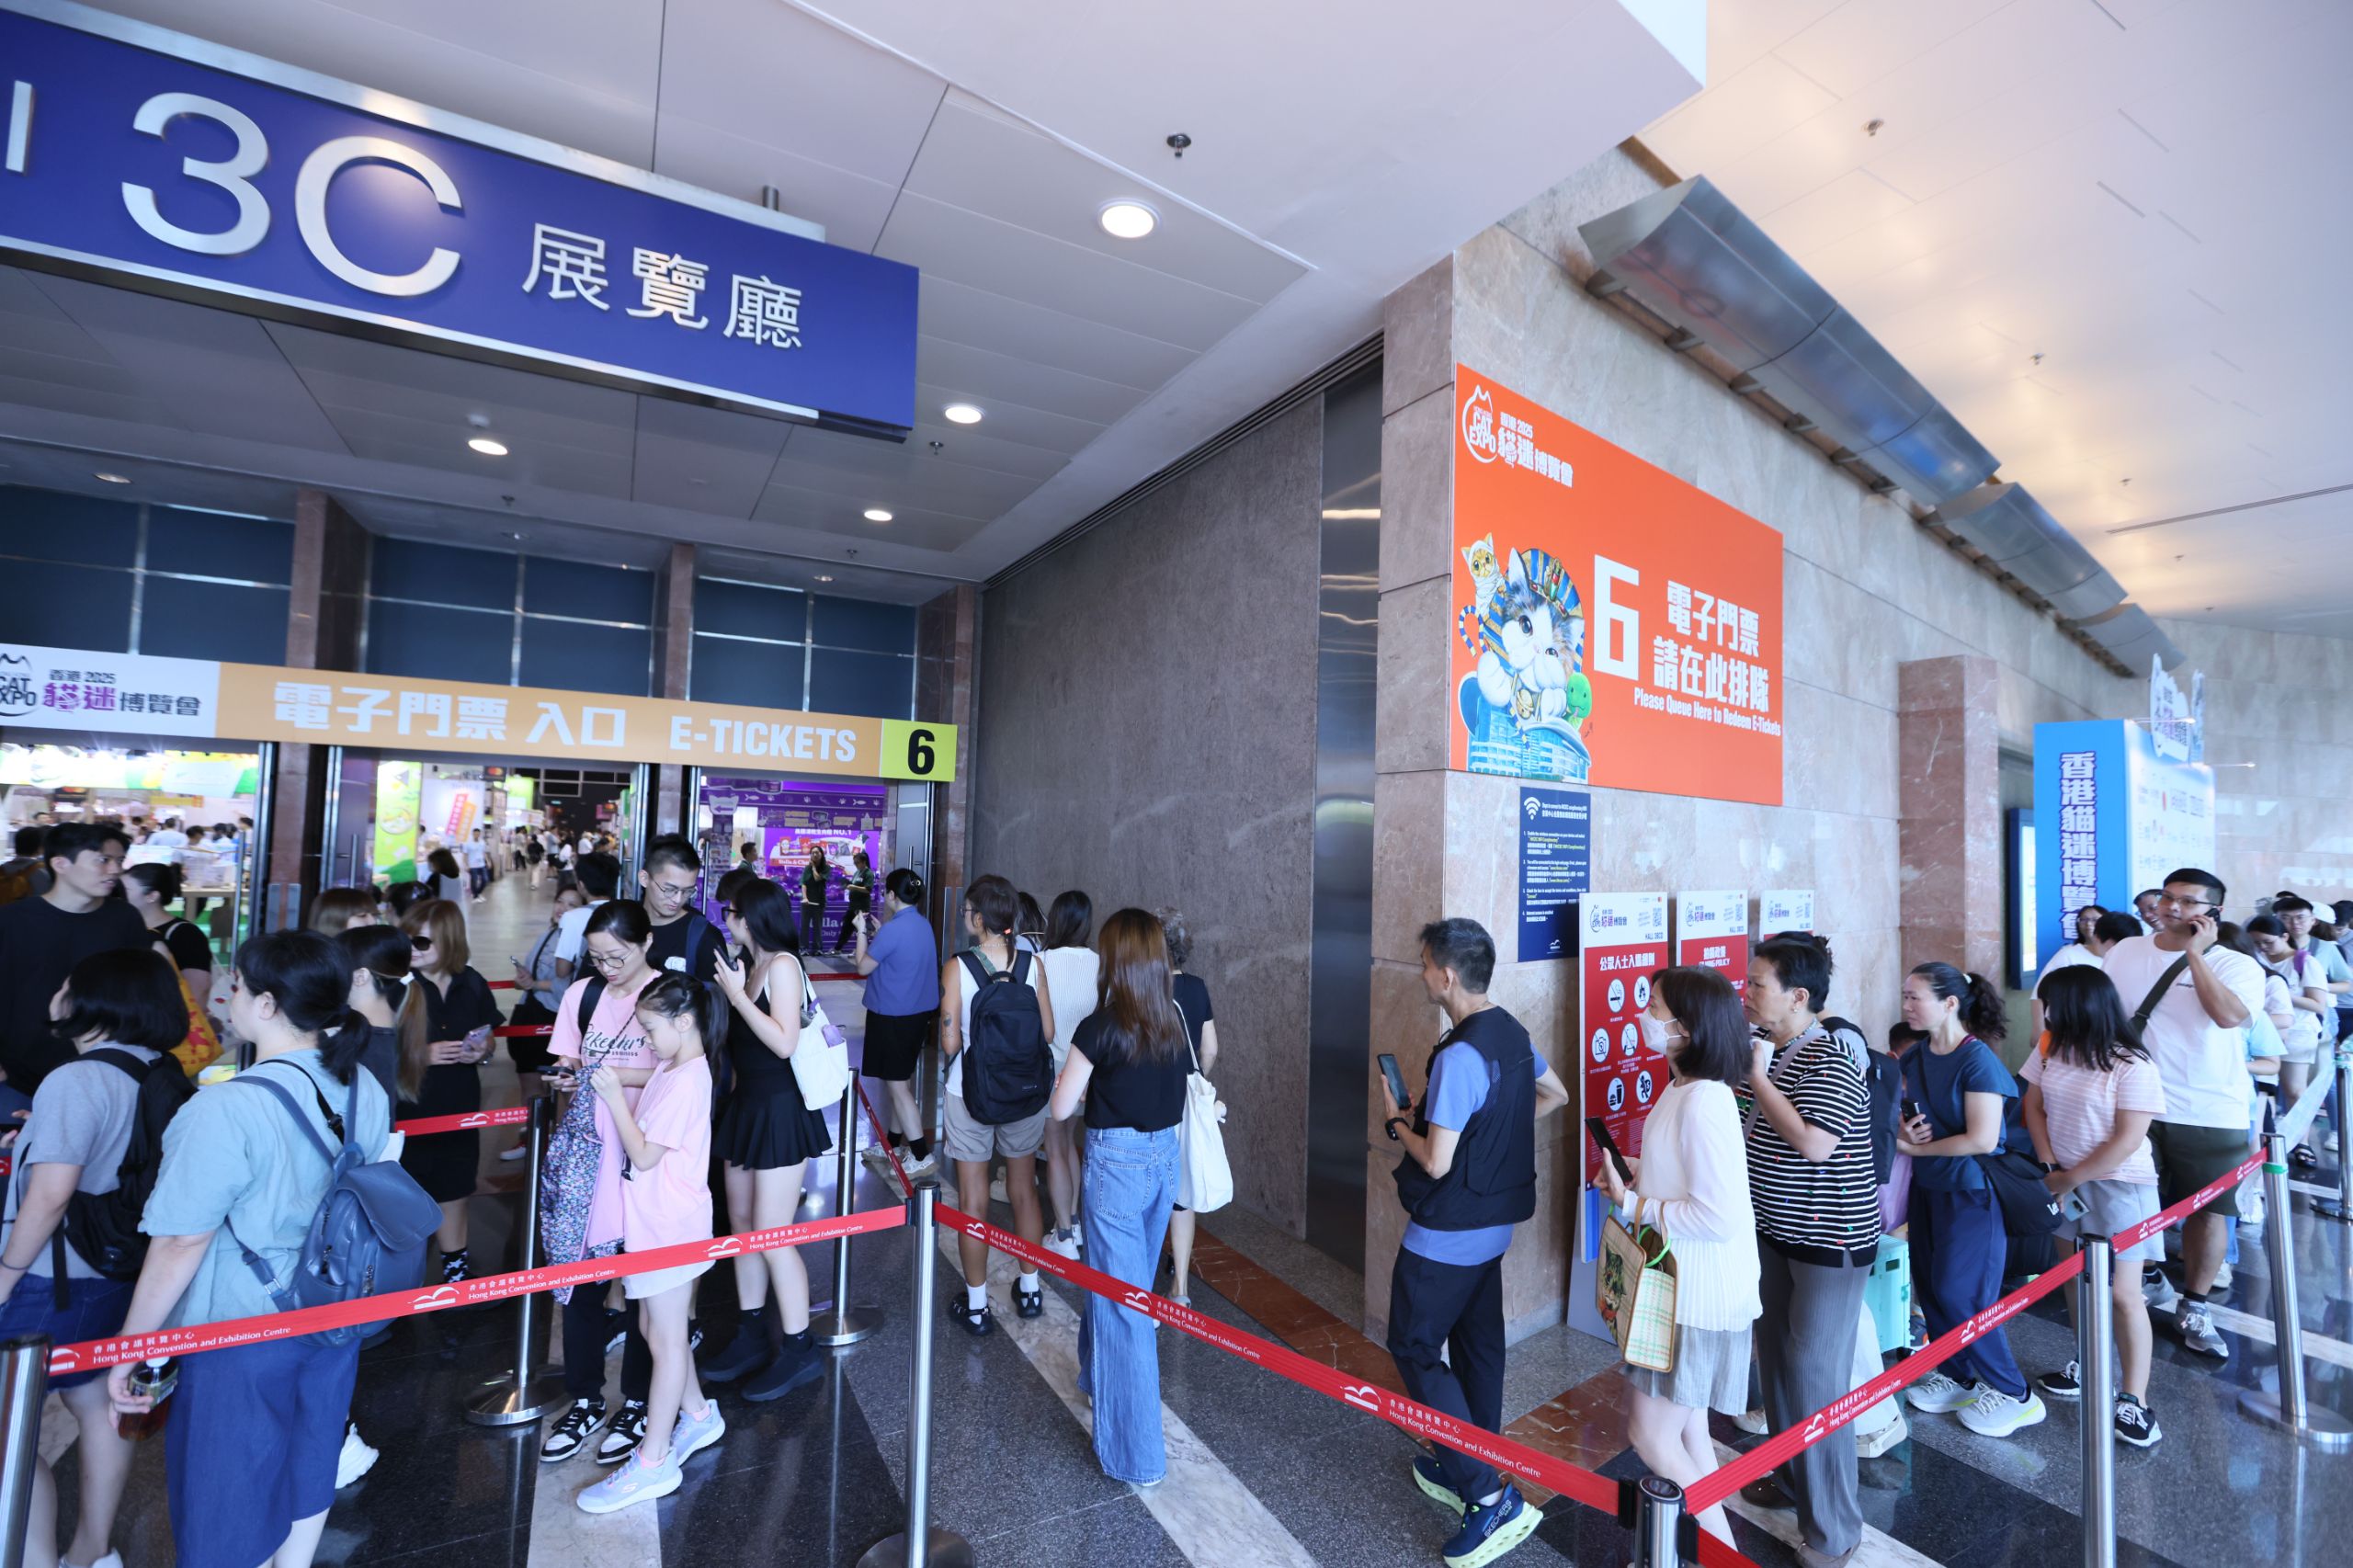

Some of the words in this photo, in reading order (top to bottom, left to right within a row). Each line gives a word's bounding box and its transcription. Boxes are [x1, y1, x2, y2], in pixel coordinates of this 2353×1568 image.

[121, 92, 462, 298] 3C
[522, 222, 802, 350] 展覽廳
[1470, 425, 1496, 453] EXPO
[1473, 411, 1493, 435] CAT
[1594, 554, 1639, 681] 6
[1667, 580, 1759, 657] 電子門票
[50, 669, 81, 682] 香港
[85, 671, 116, 684] 2025
[1654, 635, 1768, 712] 請在此排隊
[0, 688, 37, 706] XPO
[1634, 687, 1665, 710] Please
[1666, 694, 1692, 717] Queue
[1693, 701, 1712, 721] Here
[1713, 706, 1722, 723] to
[1723, 708, 1752, 730] Redeem
[1753, 715, 1781, 736] E-Tickets
[275, 682, 506, 742] 電子門票
[525, 702, 626, 747] 入口
[670, 715, 857, 762] E-TICKETS
[907, 729, 936, 775] 6
[780, 1235, 809, 1244] Convention
[821, 1228, 846, 1237] Exhibition
[847, 1224, 863, 1233] Centre
[469, 1291, 488, 1301] Hong
[490, 1288, 506, 1297] Kong
[509, 1281, 546, 1293] Convention
[563, 1272, 594, 1283] Exhibition
[596, 1268, 616, 1277] Centre
[93, 1354, 119, 1365] Hong
[121, 1348, 144, 1359] Kong
[147, 1341, 198, 1356] Convention
[200, 1338, 216, 1347] and
[219, 1331, 261, 1345] Exhibition
[263, 1327, 291, 1337] Centre
[94, 1331, 196, 1354] 香港會議展覽中心
[1156, 1310, 1169, 1321] Hong
[1169, 1315, 1181, 1326] Kong
[1181, 1320, 1208, 1337] Convention
[1208, 1333, 1218, 1342] and
[1218, 1336, 1243, 1352] Exhibition
[1244, 1346, 1260, 1359] Centre
[1390, 1399, 1461, 1434] 香港會議展覽中心
[1389, 1409, 1407, 1424] Hong
[1408, 1417, 1425, 1432] Kong
[1426, 1425, 1463, 1446] Convention
[1465, 1440, 1478, 1452] and
[1479, 1446, 1515, 1469] Exhibition
[1516, 1461, 1541, 1478] Centre
